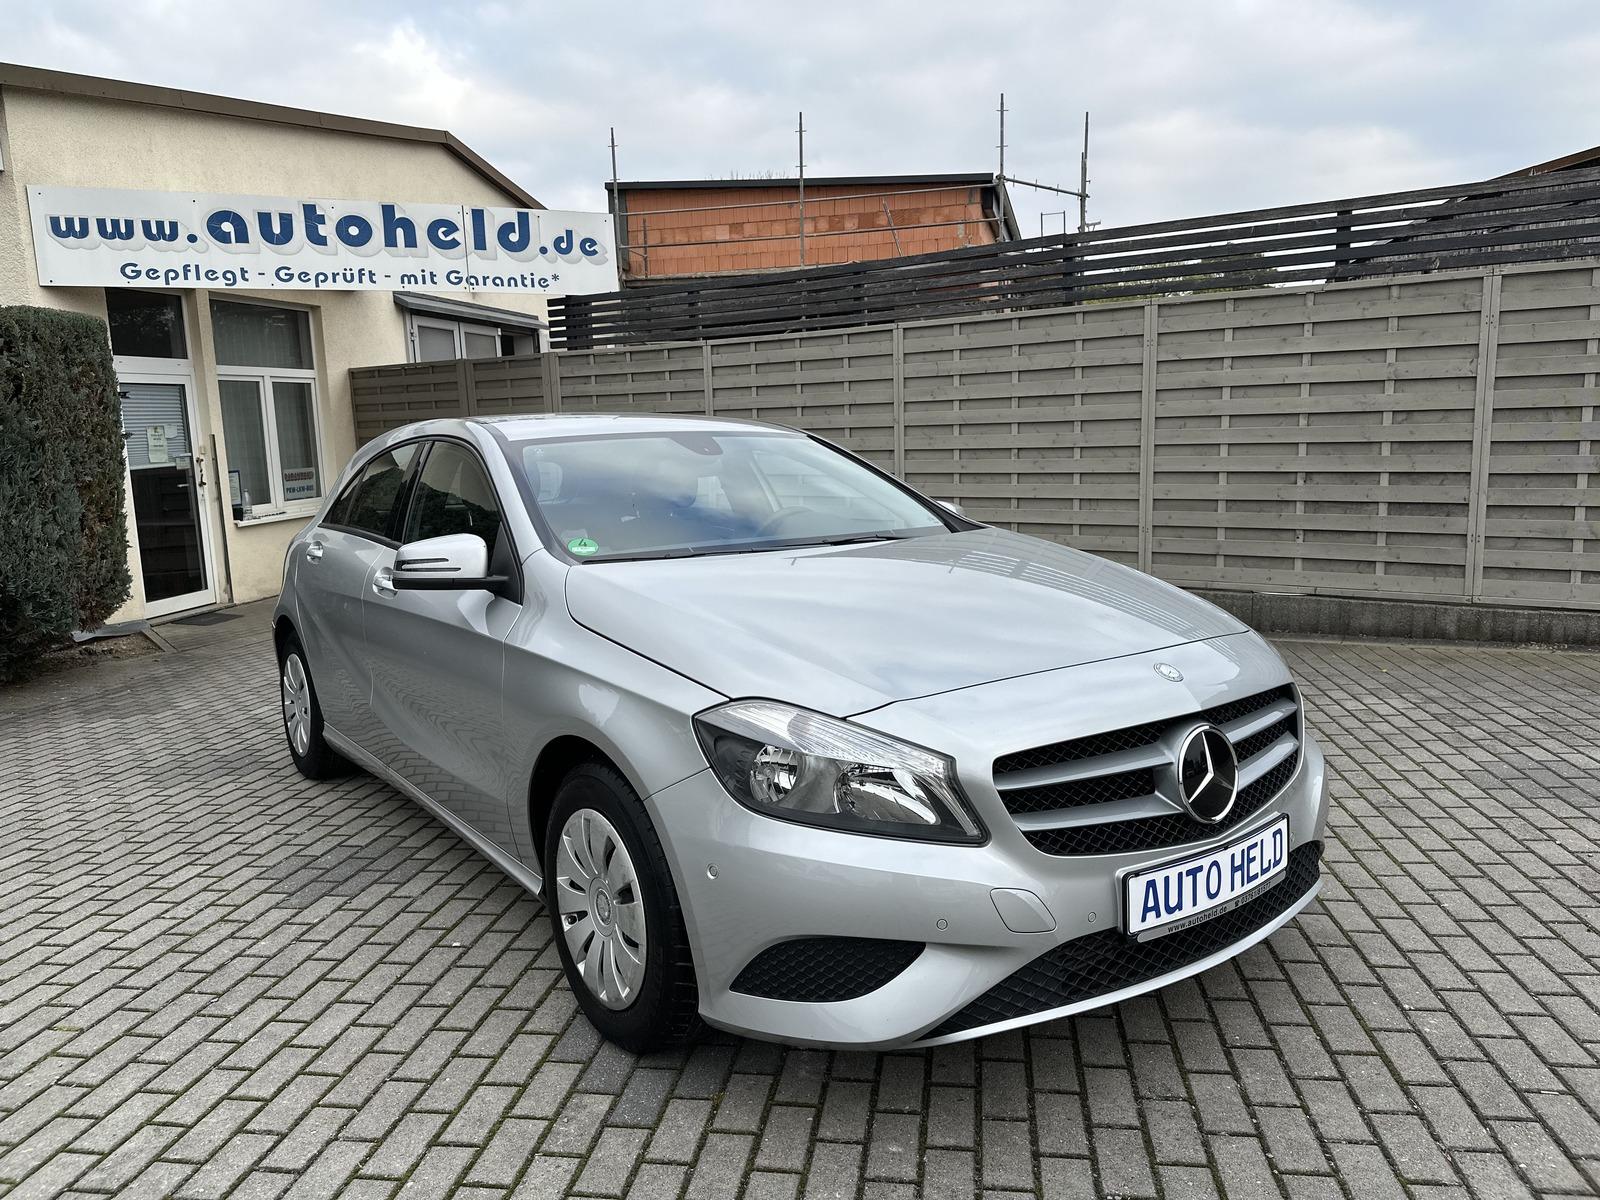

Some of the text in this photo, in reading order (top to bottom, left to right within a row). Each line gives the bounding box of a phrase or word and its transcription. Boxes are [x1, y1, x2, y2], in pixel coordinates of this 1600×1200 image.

[49, 203, 599, 257] www.autoheld.de
[119, 262, 249, 286] Gepflegt
[274, 265, 377, 288] Geprüft
[400, 268, 438, 286] mit
[1140, 827, 1283, 923] AUTO HELD
[1167, 905, 1228, 933] www.autoheld.de
